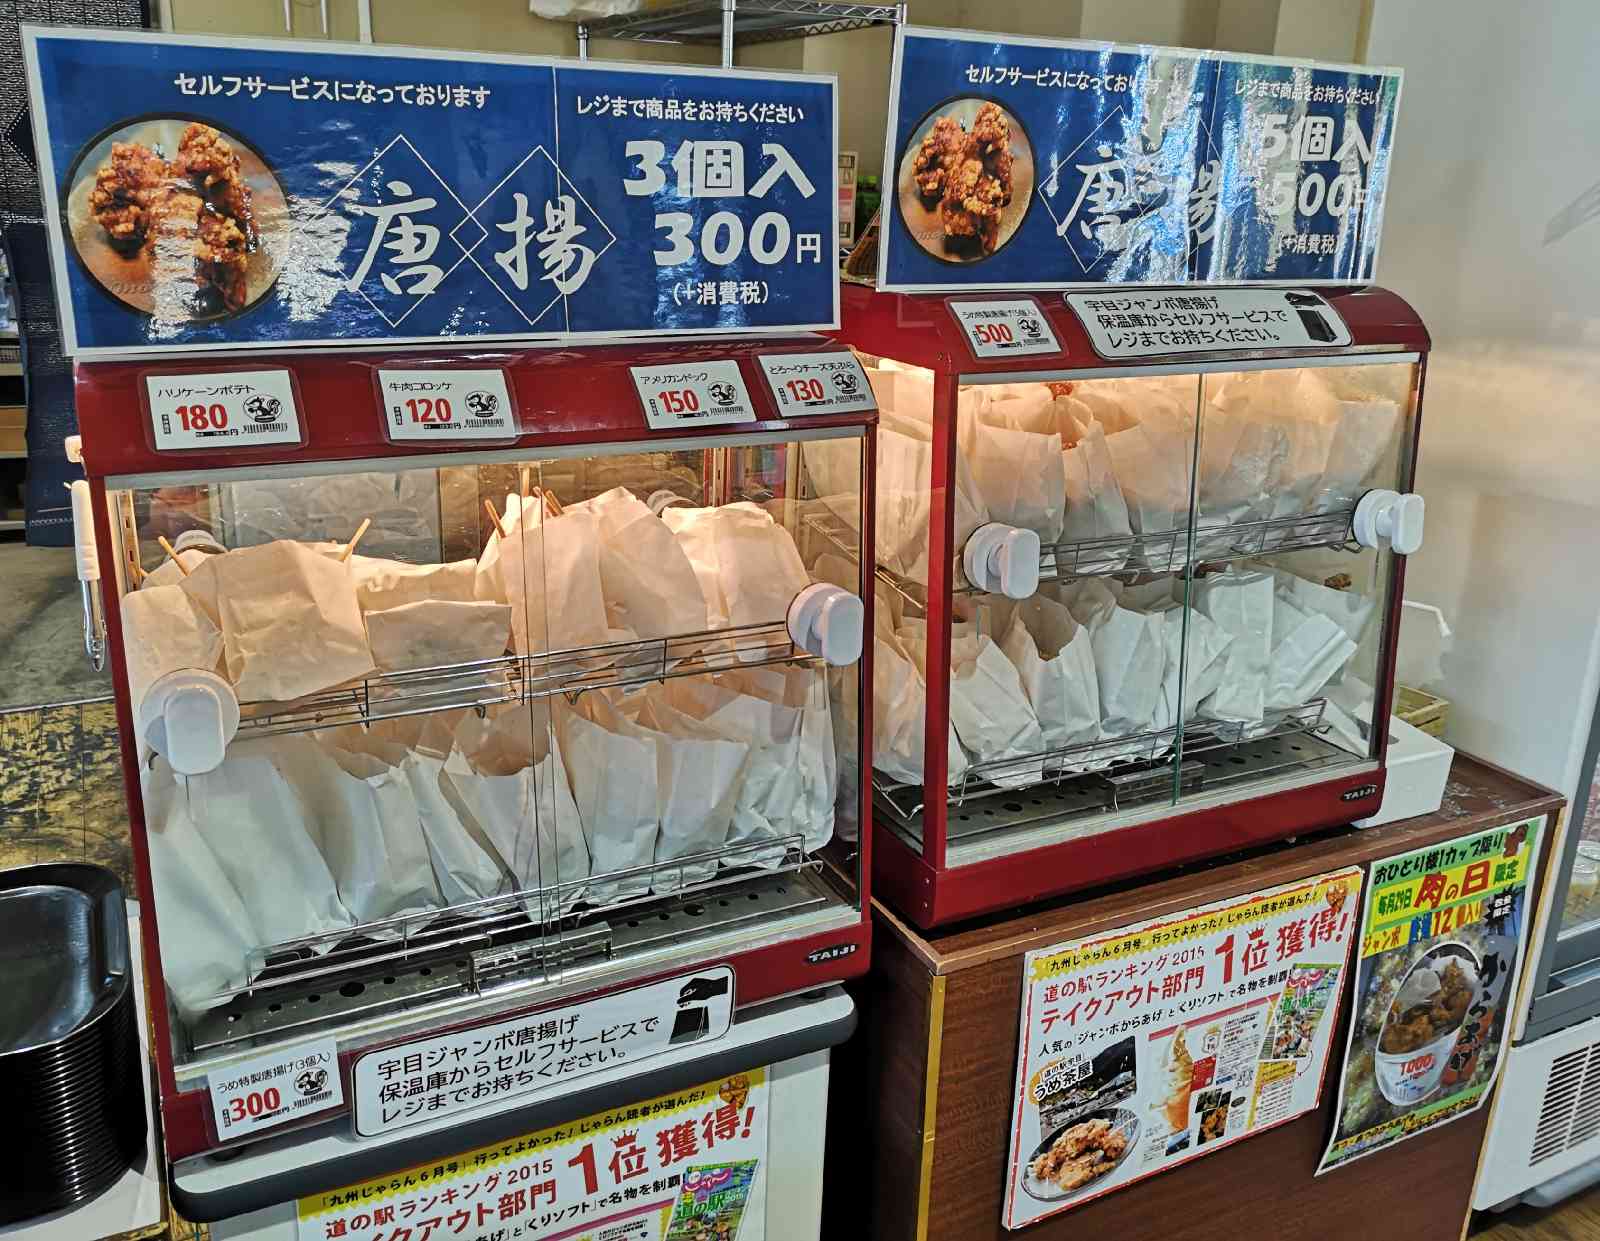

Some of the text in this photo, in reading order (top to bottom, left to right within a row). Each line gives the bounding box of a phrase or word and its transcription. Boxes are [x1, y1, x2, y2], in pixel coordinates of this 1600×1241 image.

[174, 72, 491, 109] セルフサービスになっております
[577, 95, 804, 124] レジまで商品をお持ちください
[623, 140, 817, 199] 3個入
[653, 211, 822, 267] 300円
[1084, 296, 1219, 314] 宇目ジャンボ唐揚げ
[975, 323, 1014, 344] 500
[1097, 310, 1288, 330] 保温庫からセルフサービスで
[1107, 329, 1281, 350] レジまでお持ちください。
[389, 381, 452, 392] 牛肉コロッケ
[786, 378, 824, 401] 130
[405, 398, 452, 423] 120
[658, 389, 699, 414] 150
[175, 403, 229, 431] 180
[1413, 860, 1490, 910] 肉の日
[808, 944, 856, 962] TAIJI
[1040, 965, 1205, 1035] テイクアウト部門
[377, 1014, 580, 1081] 宇目ジャンボ唐揚げ
[378, 1015, 661, 1105] 保温庫からセルフサービスで
[381, 1047, 627, 1124] レジまでお持ちください。
[228, 1087, 281, 1122] 300
